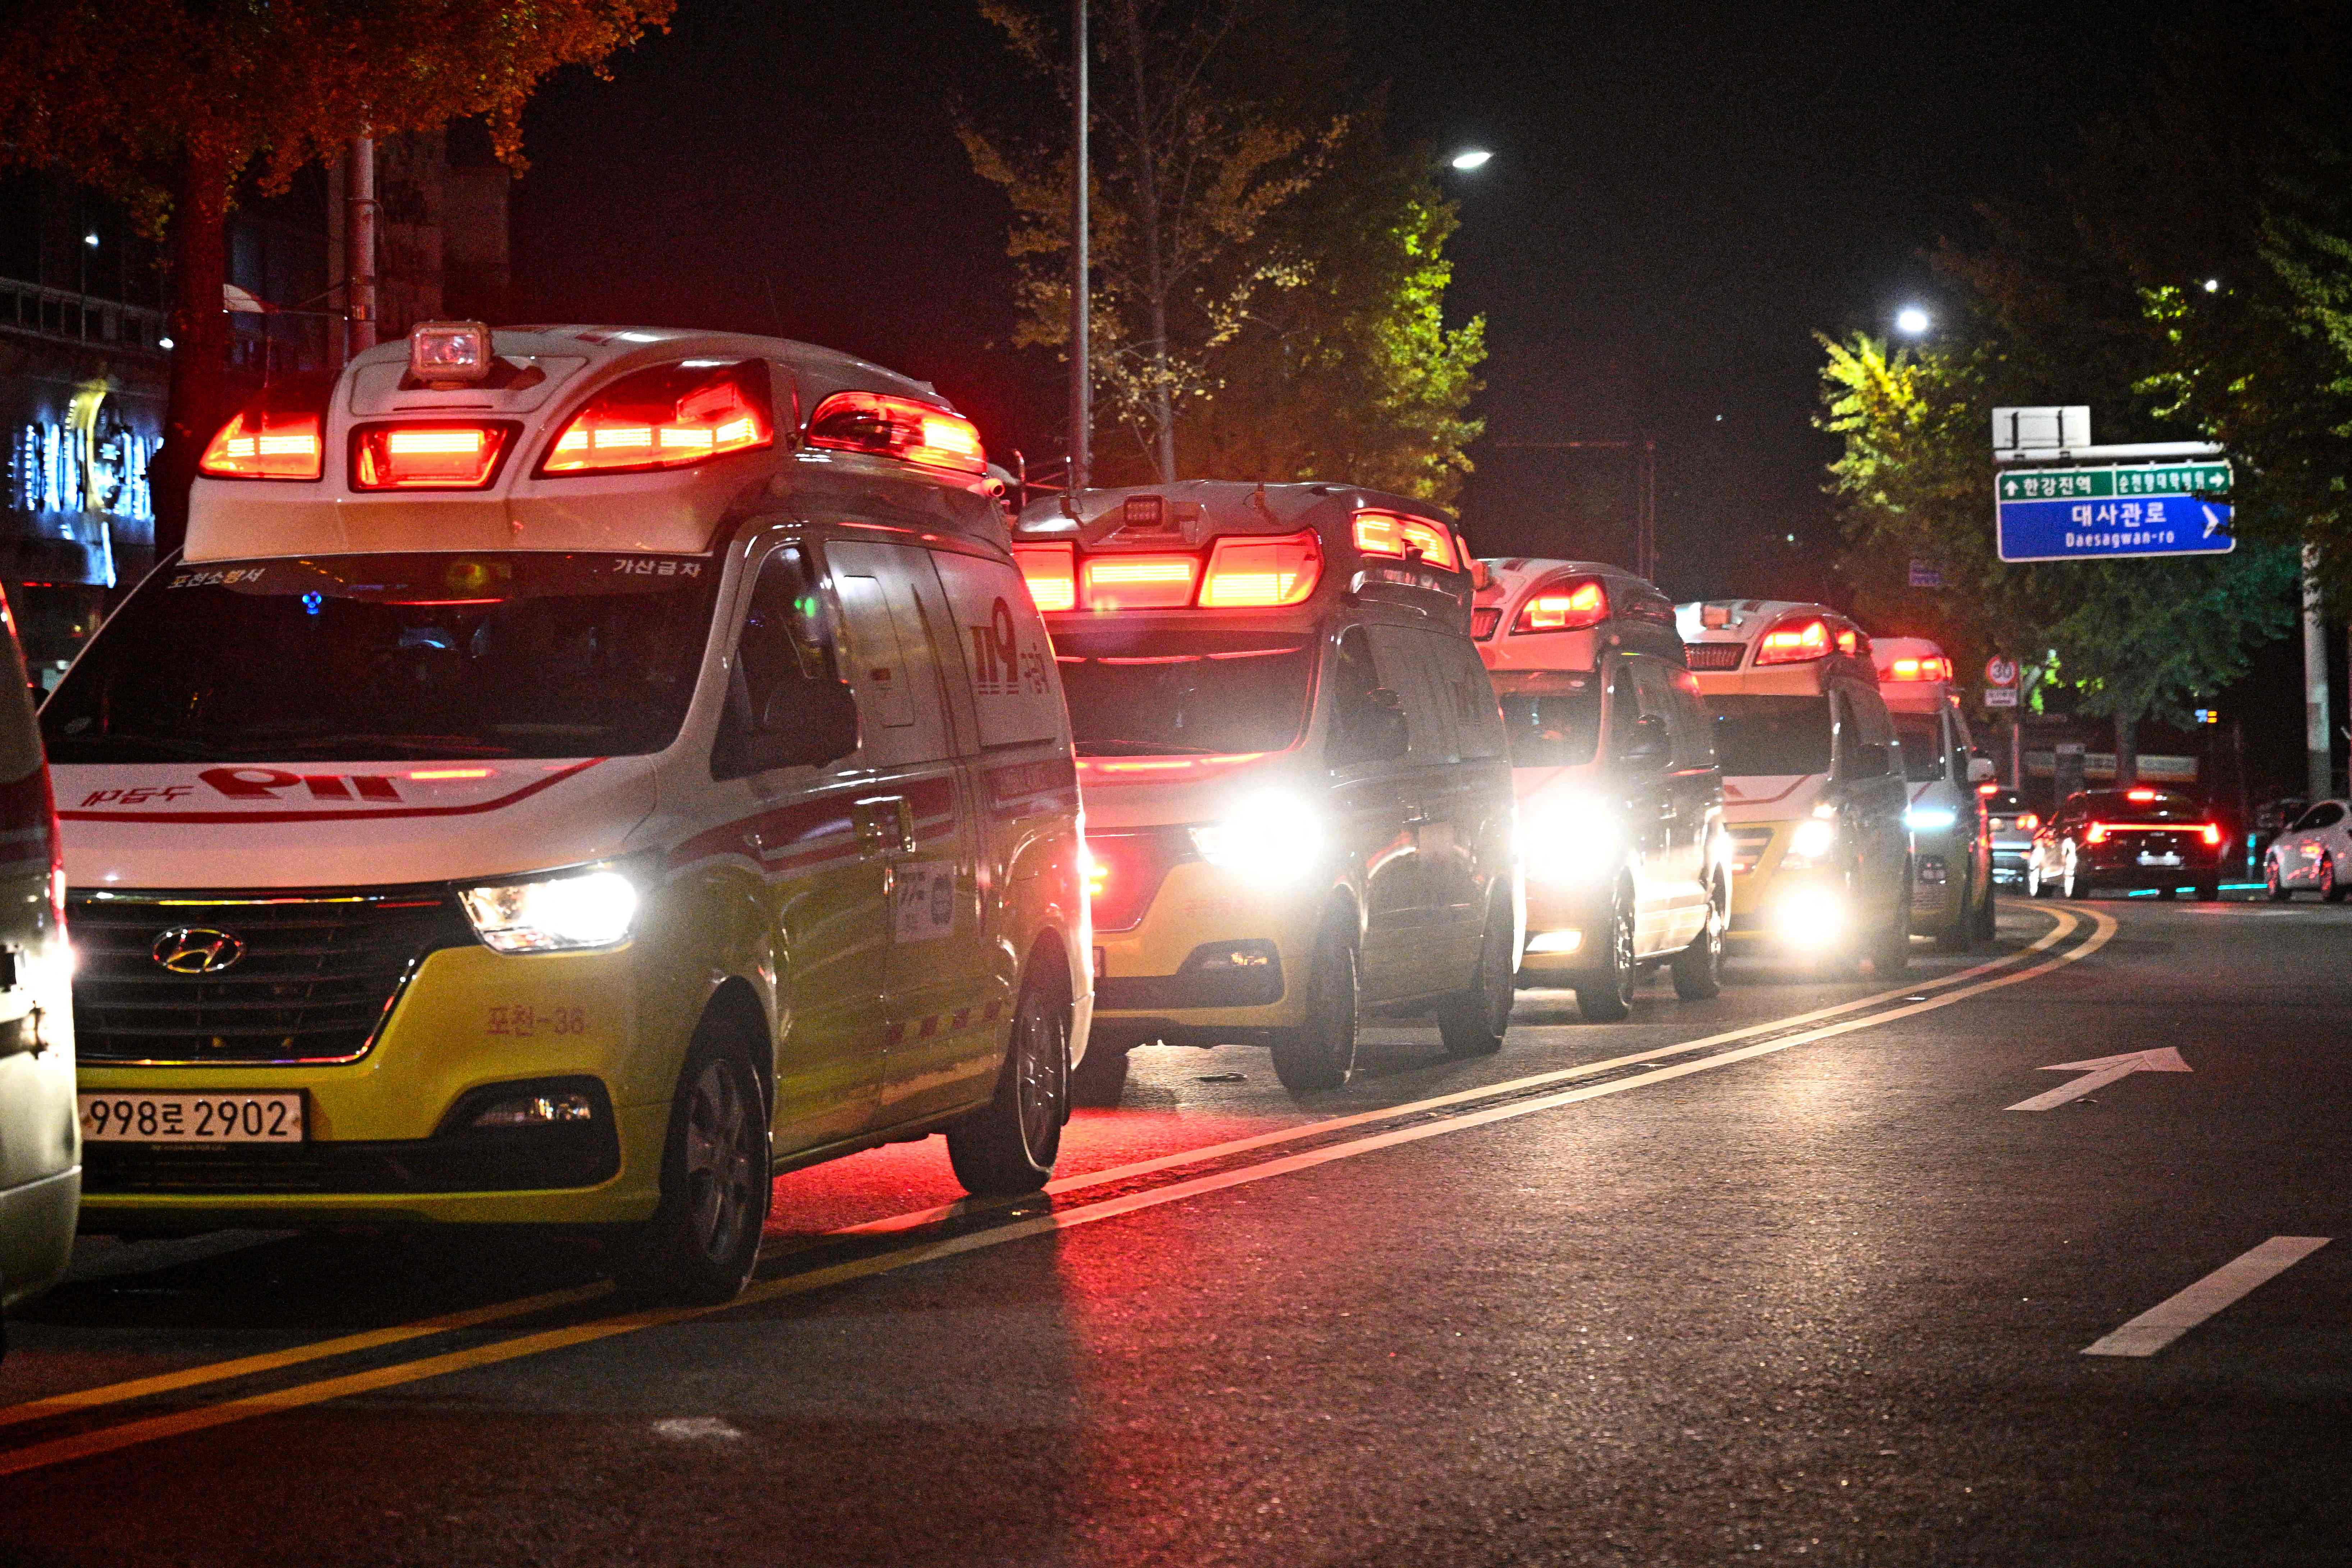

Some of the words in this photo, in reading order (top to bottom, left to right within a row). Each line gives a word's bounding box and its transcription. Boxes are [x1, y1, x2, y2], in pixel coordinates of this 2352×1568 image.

[2023, 475, 2091, 496] 한강진역
[2072, 502, 2167, 527] 대사관로
[2065, 531, 2175, 548] Daesagwan-ro
[166, 568, 266, 589] 포천소방서
[91, 1100, 184, 1135] 998로
[194, 1100, 287, 1136] 2902
